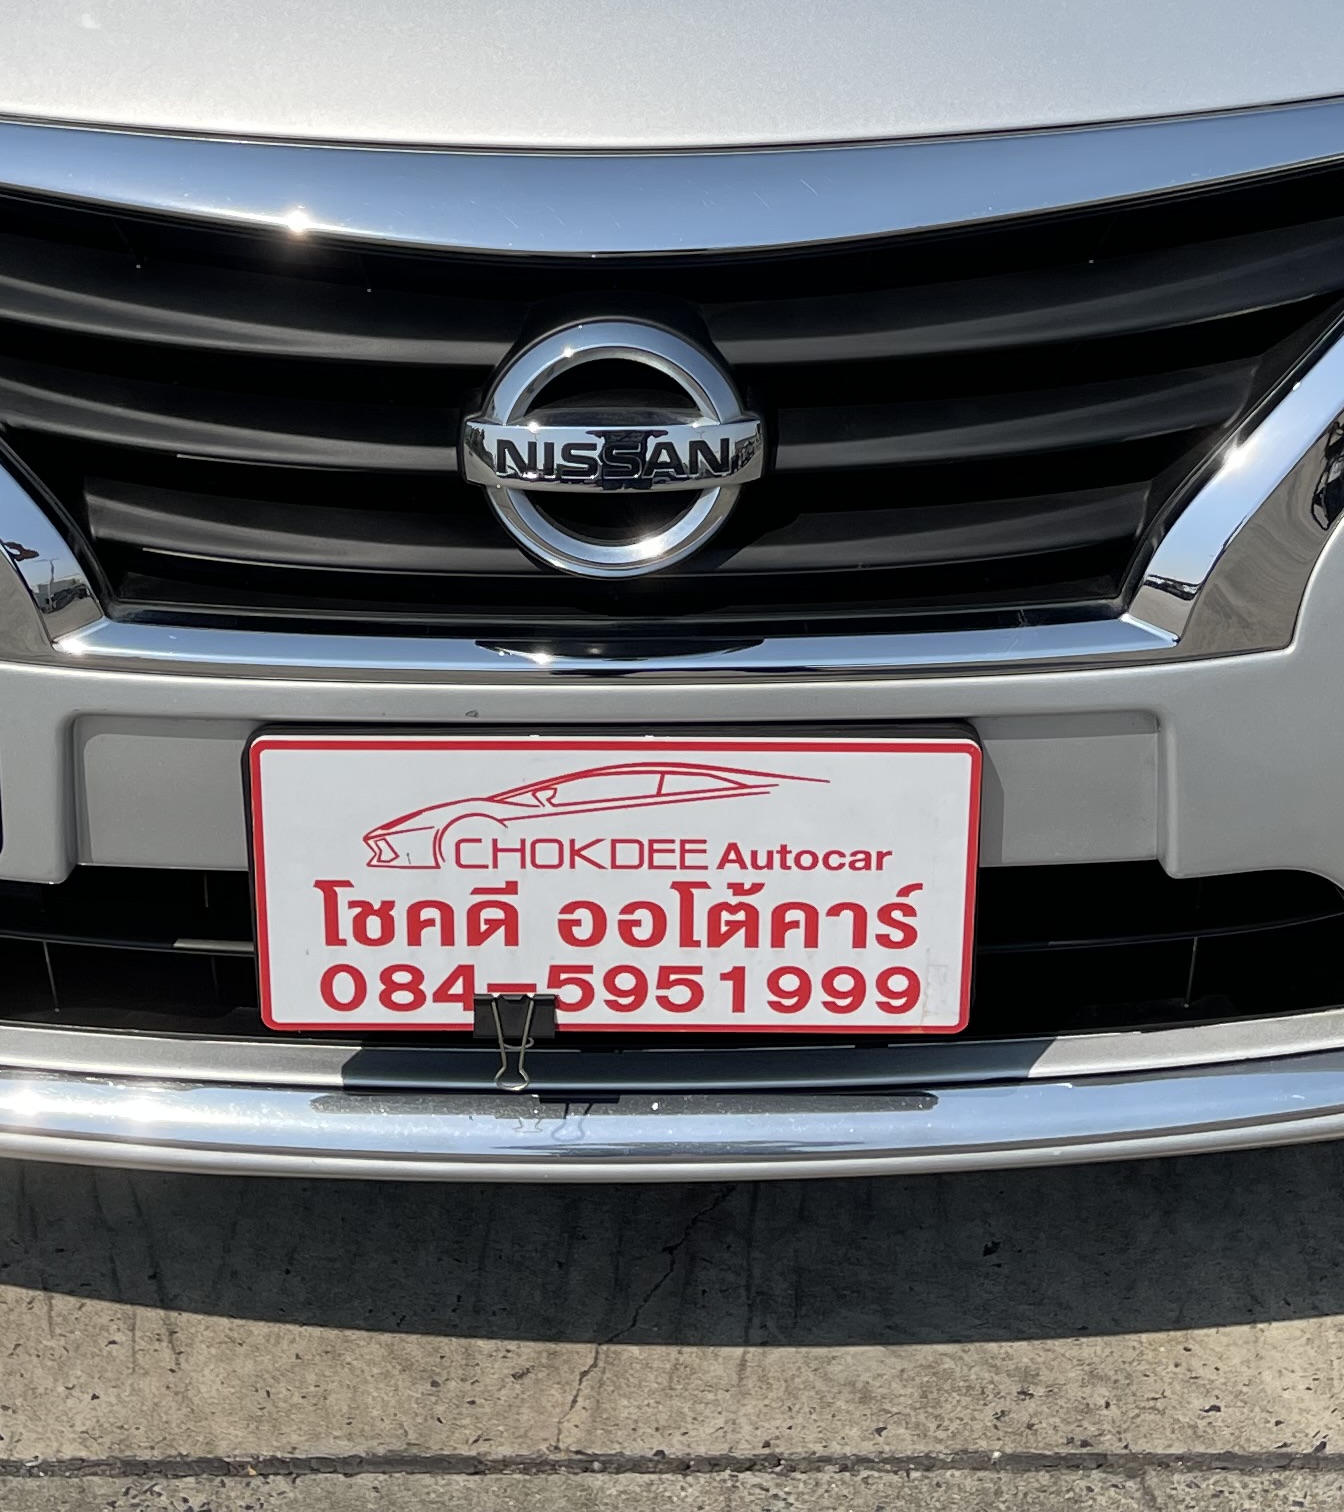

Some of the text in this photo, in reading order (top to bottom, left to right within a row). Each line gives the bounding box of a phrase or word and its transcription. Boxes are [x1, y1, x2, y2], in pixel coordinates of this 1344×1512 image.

[496, 438, 730, 478] NISSAN
[454, 837, 894, 872] CHOKDEE Autocar
[312, 879, 924, 950] โชคดี ออโต้คาร์
[319, 963, 922, 1015] 084-5951999
